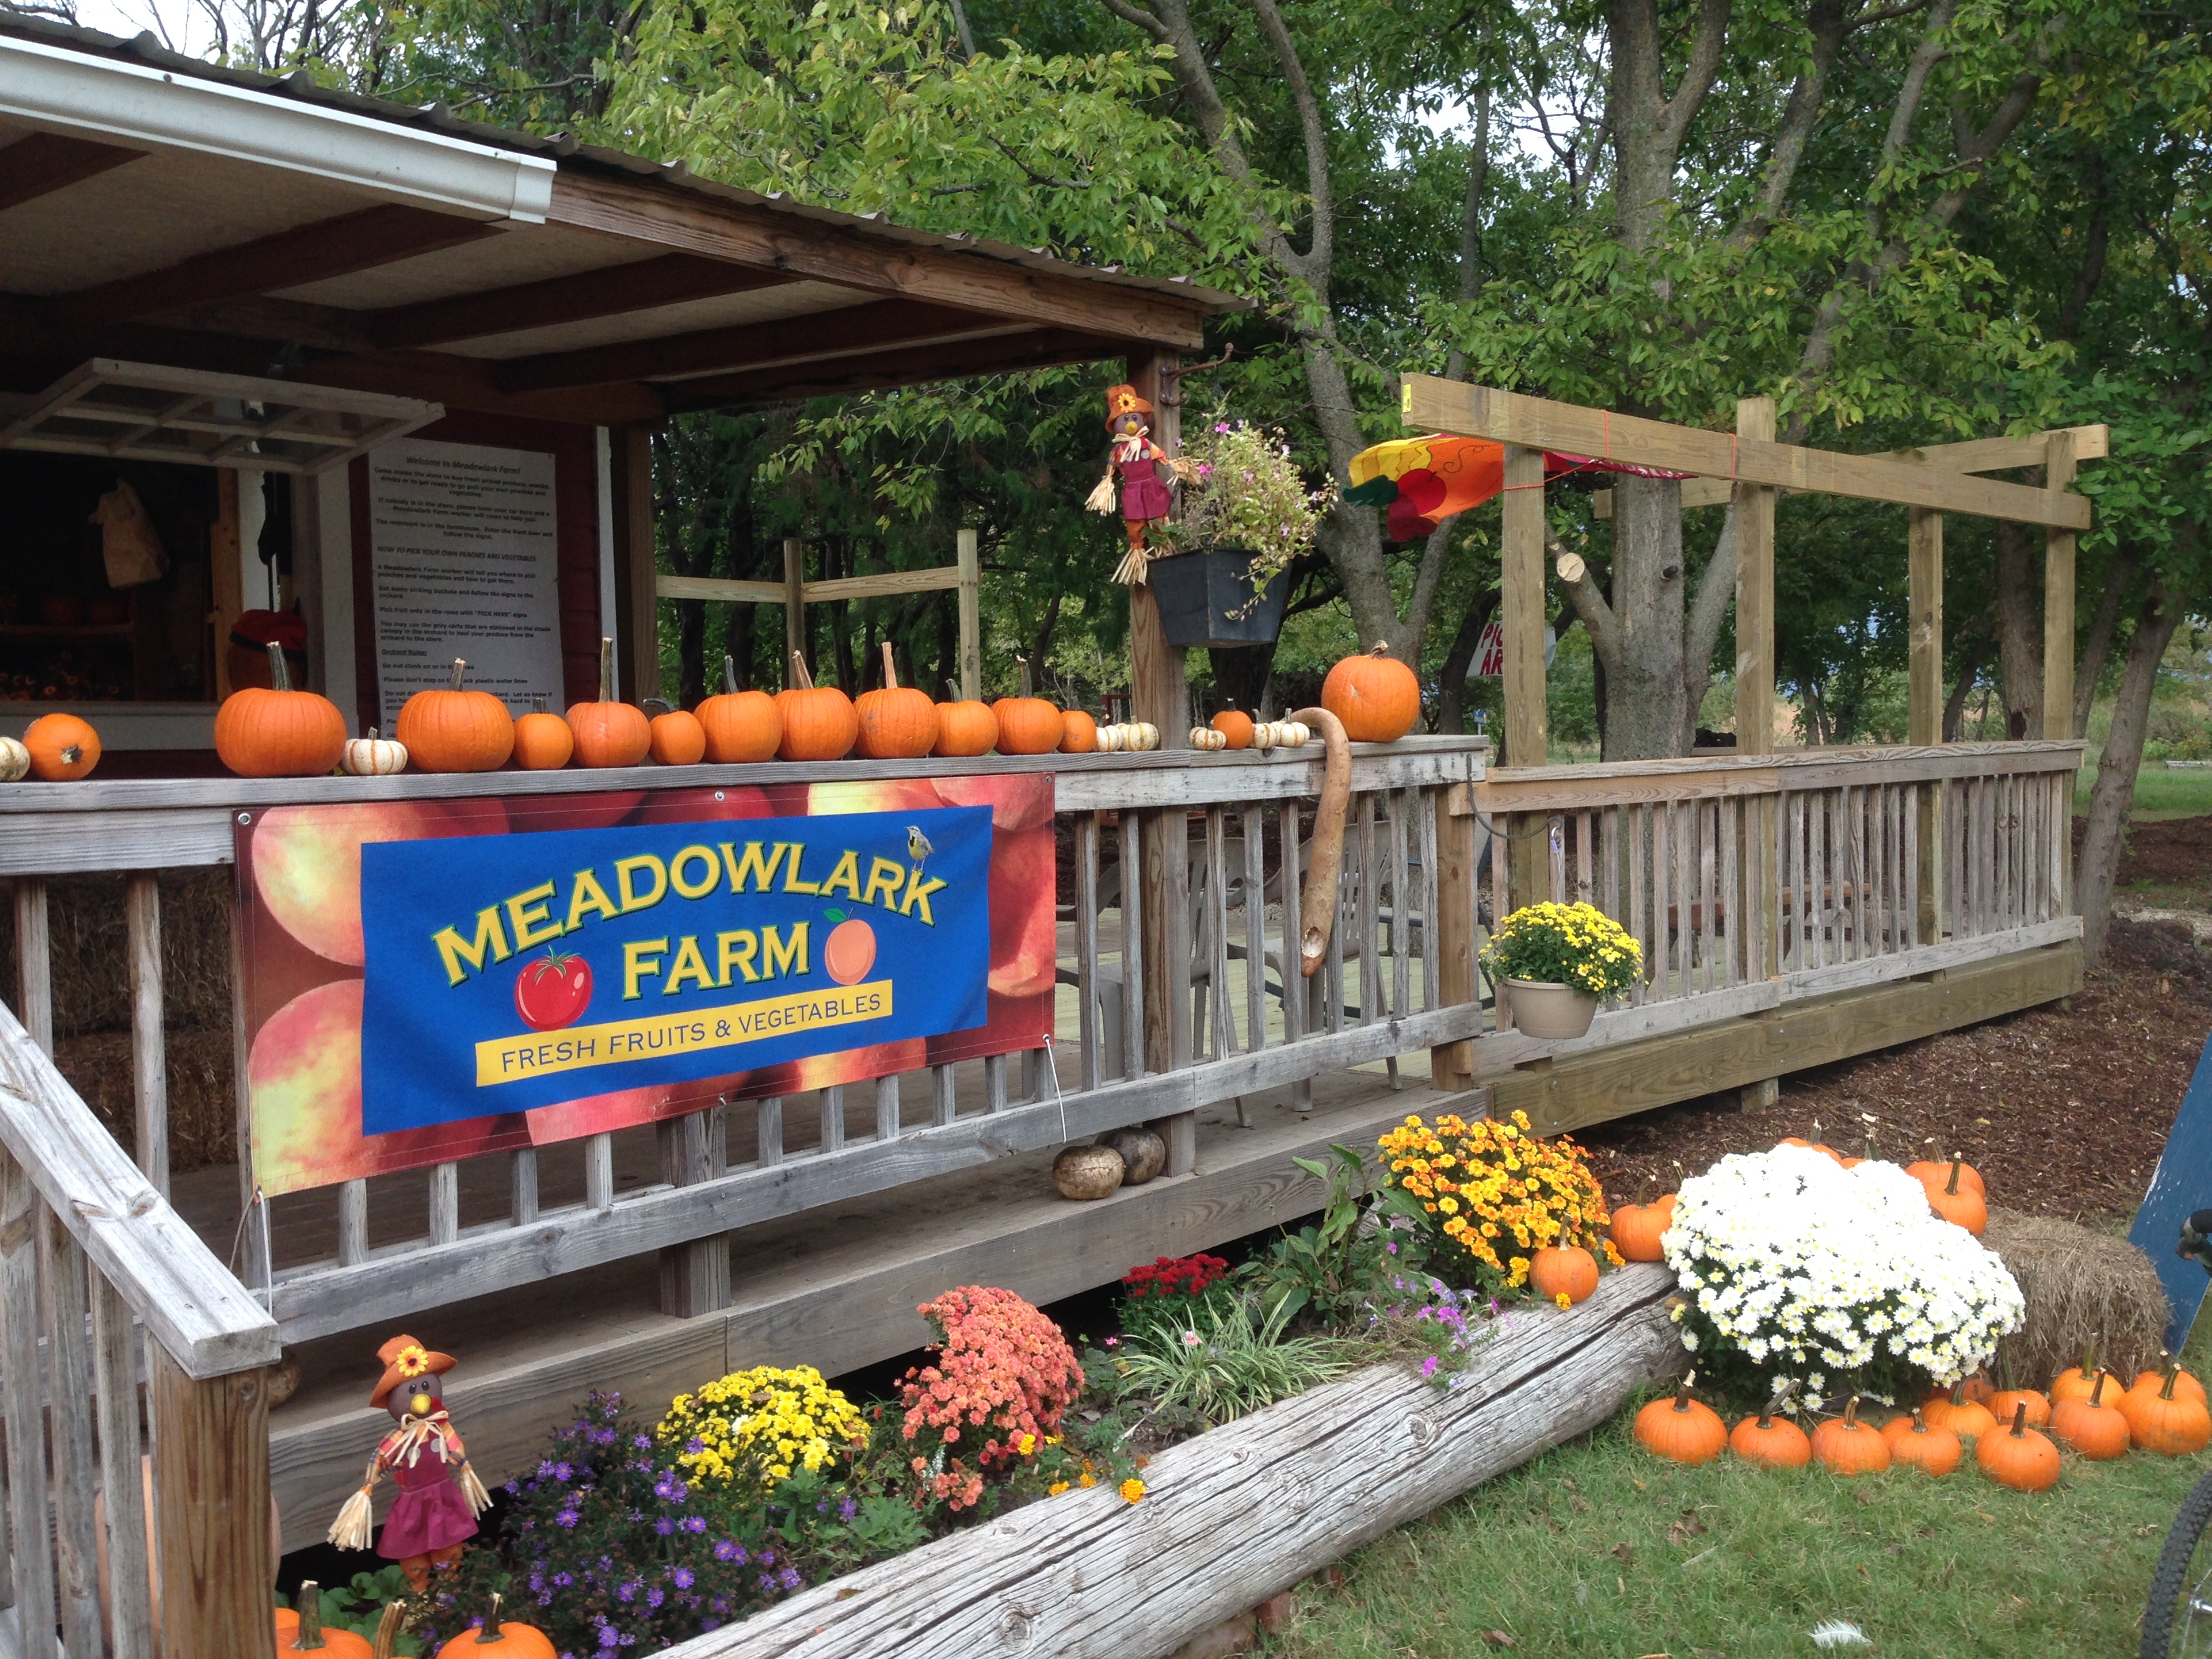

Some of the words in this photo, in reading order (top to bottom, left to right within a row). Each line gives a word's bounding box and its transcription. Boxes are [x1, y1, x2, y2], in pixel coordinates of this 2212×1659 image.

[459, 551, 486, 559] PEACHES
[501, 554, 536, 562] VEGETABLES
[1479, 649, 1503, 676] AR
[1481, 623, 1503, 649] PIC
[430, 840, 948, 988] MEADOWLARK
[621, 921, 811, 1000] FARM
[501, 1038, 596, 1073] FRESH
[610, 1023, 705, 1054] FRUITS
[715, 1019, 731, 1038] &
[738, 994, 881, 1034] VEGETABLES
